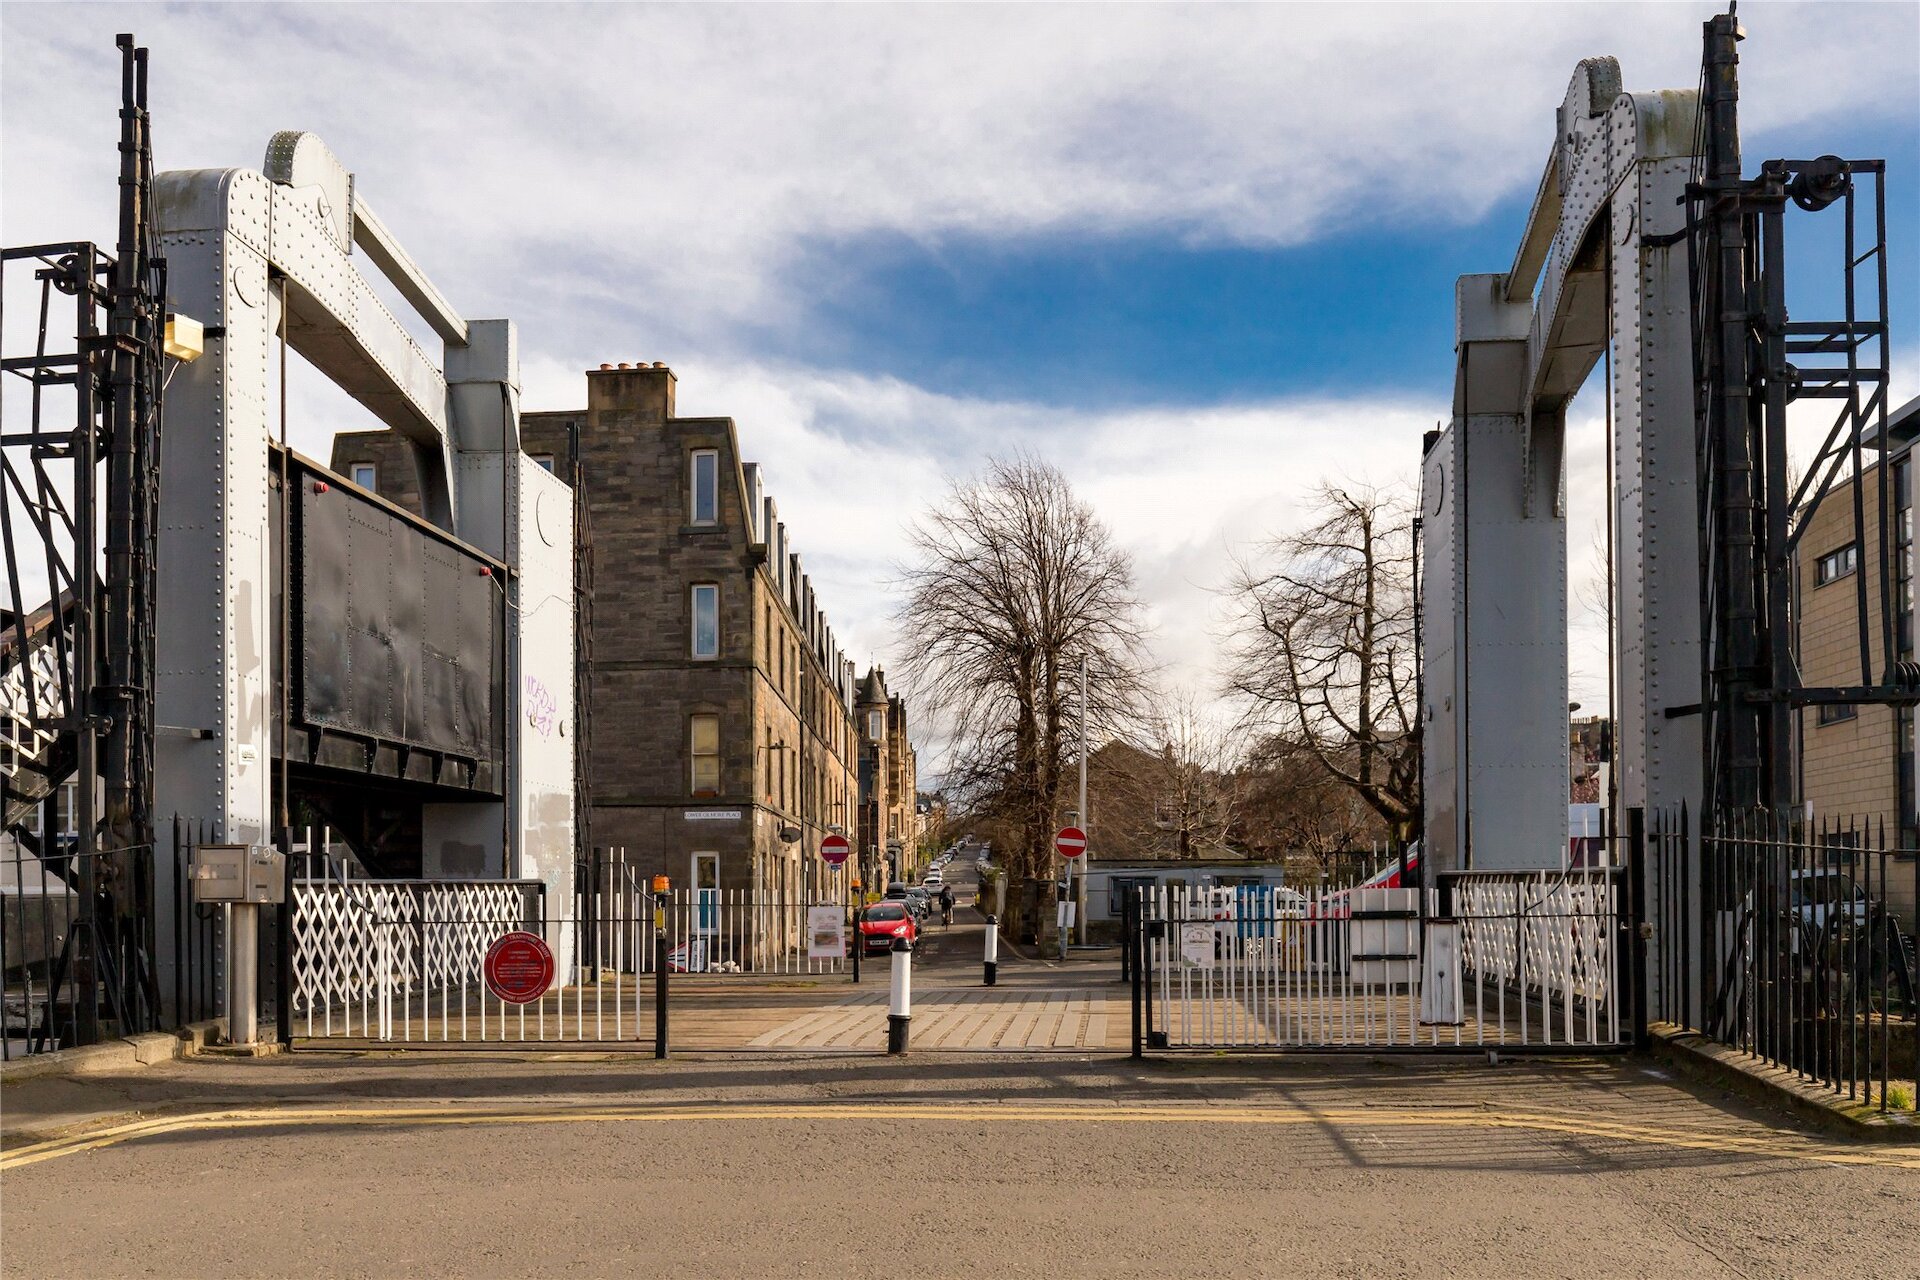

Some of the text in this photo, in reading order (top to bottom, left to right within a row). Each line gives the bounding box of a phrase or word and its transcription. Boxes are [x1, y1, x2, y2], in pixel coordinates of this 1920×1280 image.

[489, 934, 550, 959] NATIONAL TRANSPORT TRUST
